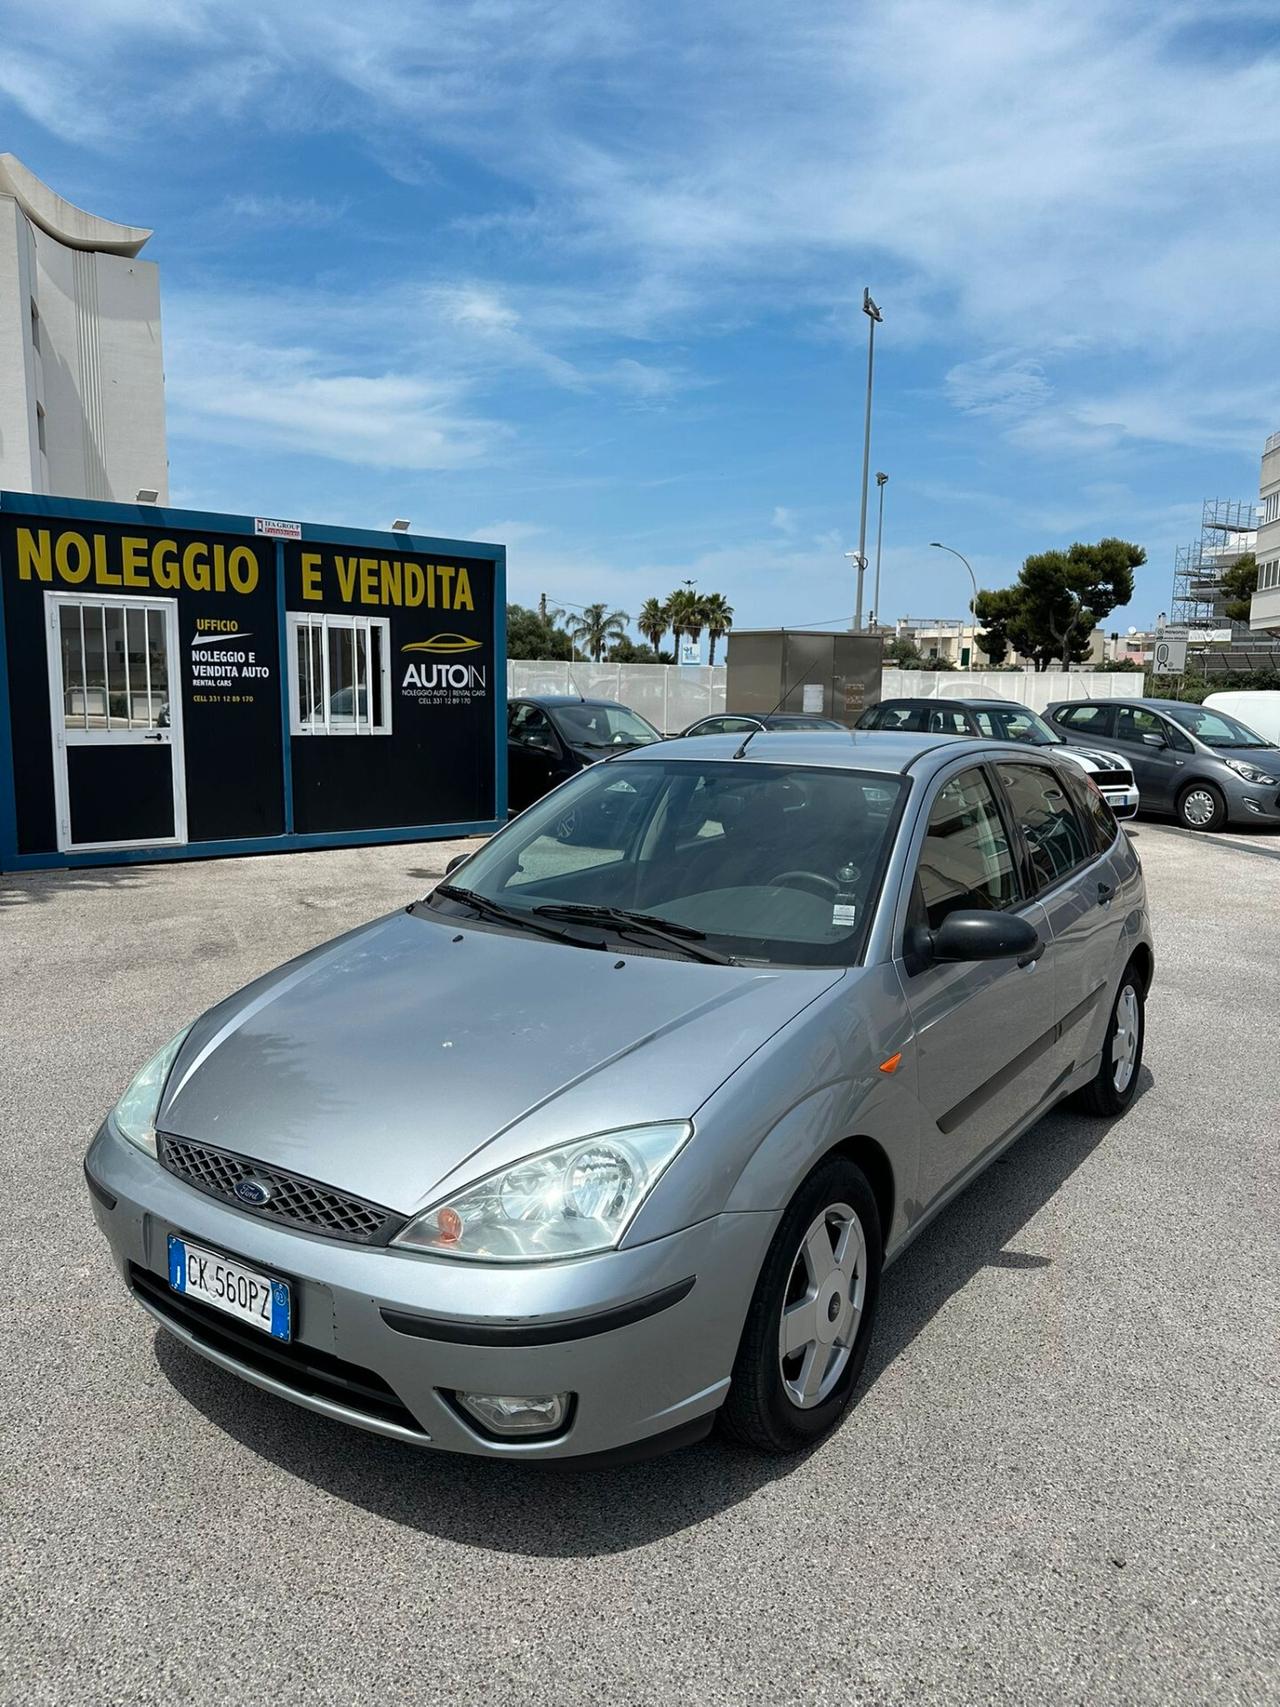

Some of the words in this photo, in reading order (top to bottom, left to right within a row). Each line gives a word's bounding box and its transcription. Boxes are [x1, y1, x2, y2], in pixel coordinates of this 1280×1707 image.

[276, 521, 300, 530] GROUP
[16, 528, 259, 594] NOLEGGIO
[302, 553, 323, 600] E
[334, 556, 475, 611] VENDITA
[196, 619, 239, 632] UFFICIO
[192, 650, 246, 663] NOLEGGIO
[248, 652, 256, 663] E
[192, 665, 239, 677] VENDITA
[241, 666, 270, 678] AUTO
[192, 679, 216, 687] RENTAL
[402, 689, 433, 697] NOLEGGIO
[240, 1183, 261, 1200] Ford
